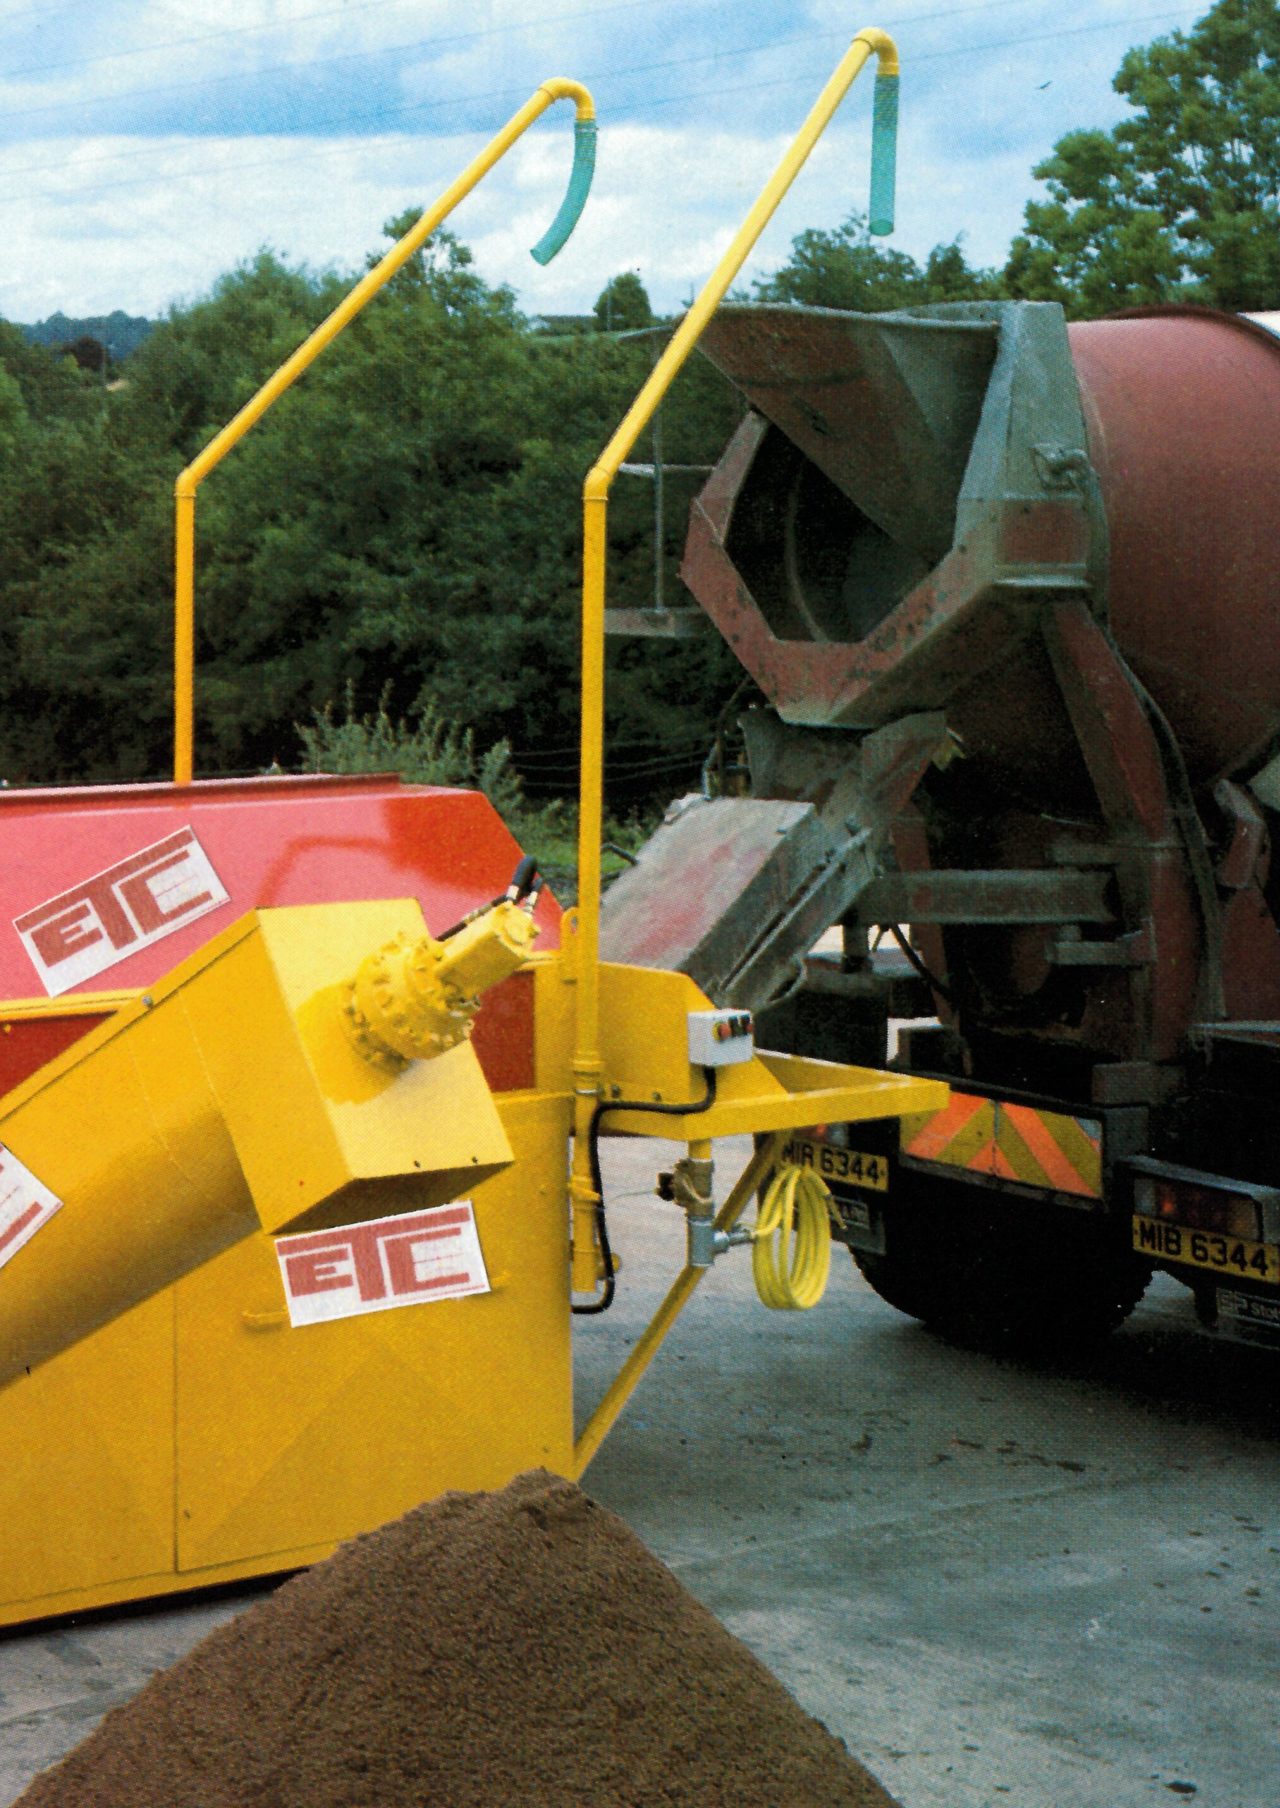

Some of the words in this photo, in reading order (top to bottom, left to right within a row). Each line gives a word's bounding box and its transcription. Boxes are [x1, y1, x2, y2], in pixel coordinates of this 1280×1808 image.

[14, 828, 214, 969] ETC
[820, 1146, 880, 1185] 6344
[276, 1206, 471, 1302] ETC
[1139, 1220, 1182, 1256] MIB
[1190, 1232, 1269, 1277] 6344
